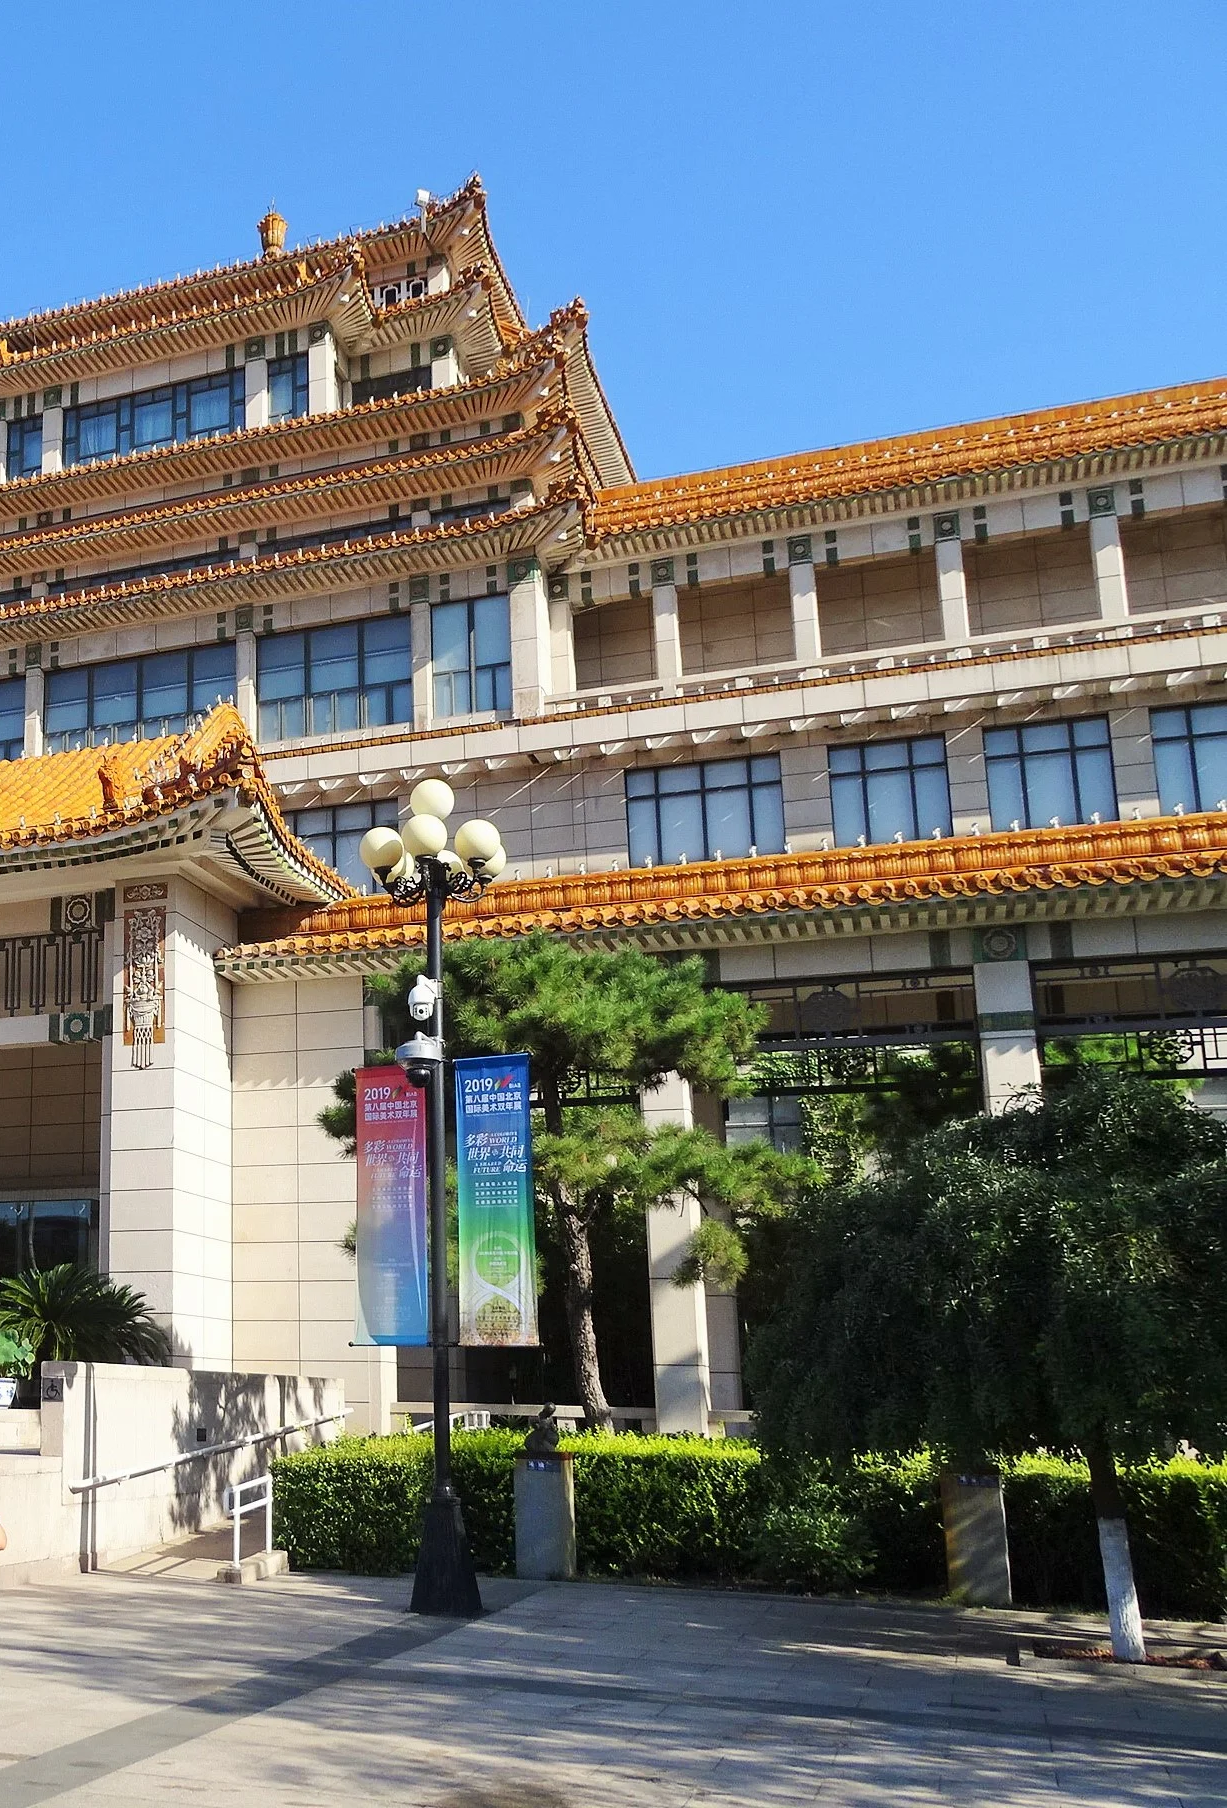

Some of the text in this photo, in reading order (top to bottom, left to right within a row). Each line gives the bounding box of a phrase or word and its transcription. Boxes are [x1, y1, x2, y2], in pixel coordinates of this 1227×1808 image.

[465, 1078, 493, 1092] 2019
[364, 1087, 391, 1101] 2019
[465, 1092, 522, 1104] 第八届中国北京
[364, 1100, 418, 1112] 第八届中国北京
[465, 1101, 522, 1114] 国际美术双年展
[365, 1110, 418, 1121] 国际美术双年展
[363, 1139, 386, 1154] 多彩
[464, 1132, 489, 1148] 多彩
[489, 1136, 518, 1144] WORLD
[399, 1165, 423, 1178] 命运
[473, 1166, 501, 1174] FUTURE
[503, 1158, 528, 1173] 命运
